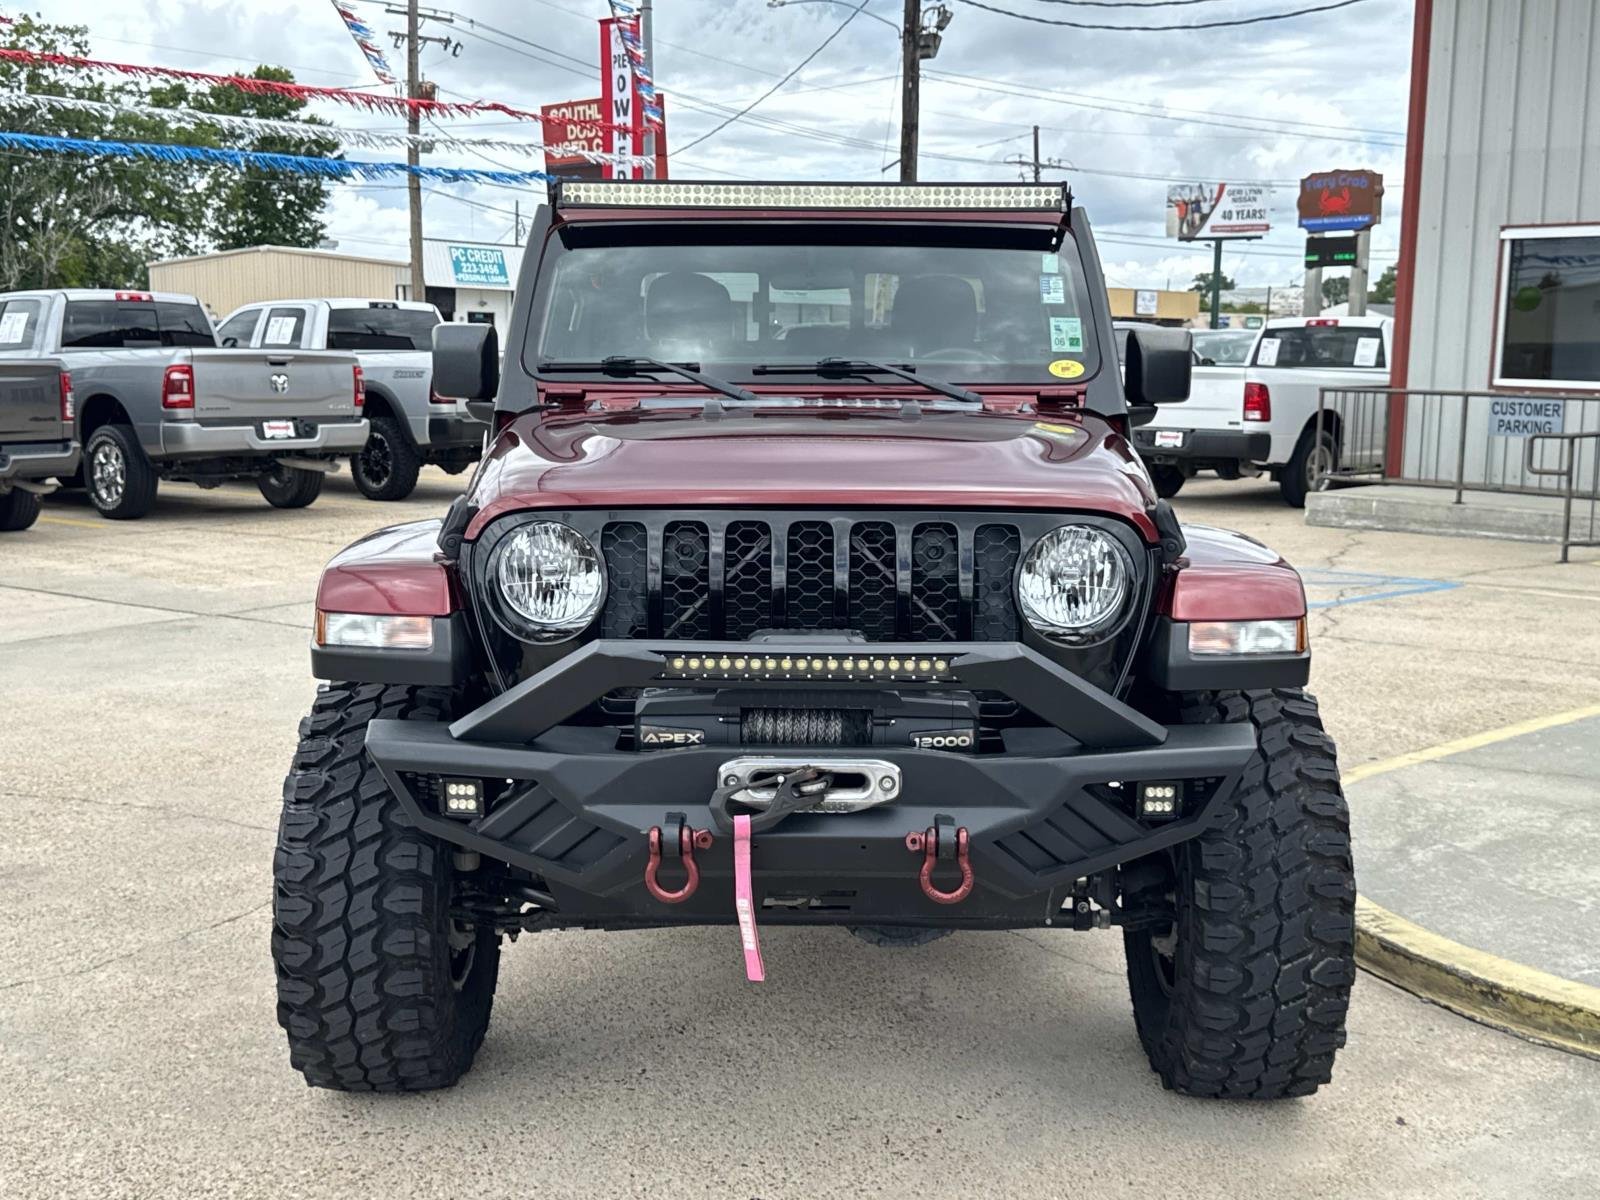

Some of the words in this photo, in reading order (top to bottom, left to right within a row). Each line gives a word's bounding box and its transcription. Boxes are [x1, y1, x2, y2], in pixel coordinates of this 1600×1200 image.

[549, 103, 603, 121] SOUTHL
[1221, 210, 1233, 220] 40
[451, 247, 466, 262] PC
[467, 249, 503, 265] CREDIT
[460, 262, 500, 274] 223-3456
[1491, 401, 1561, 418] CUSTOMER
[1497, 418, 1552, 434] PARKING
[643, 732, 701, 743] APEX
[913, 736, 970, 750] 12000
